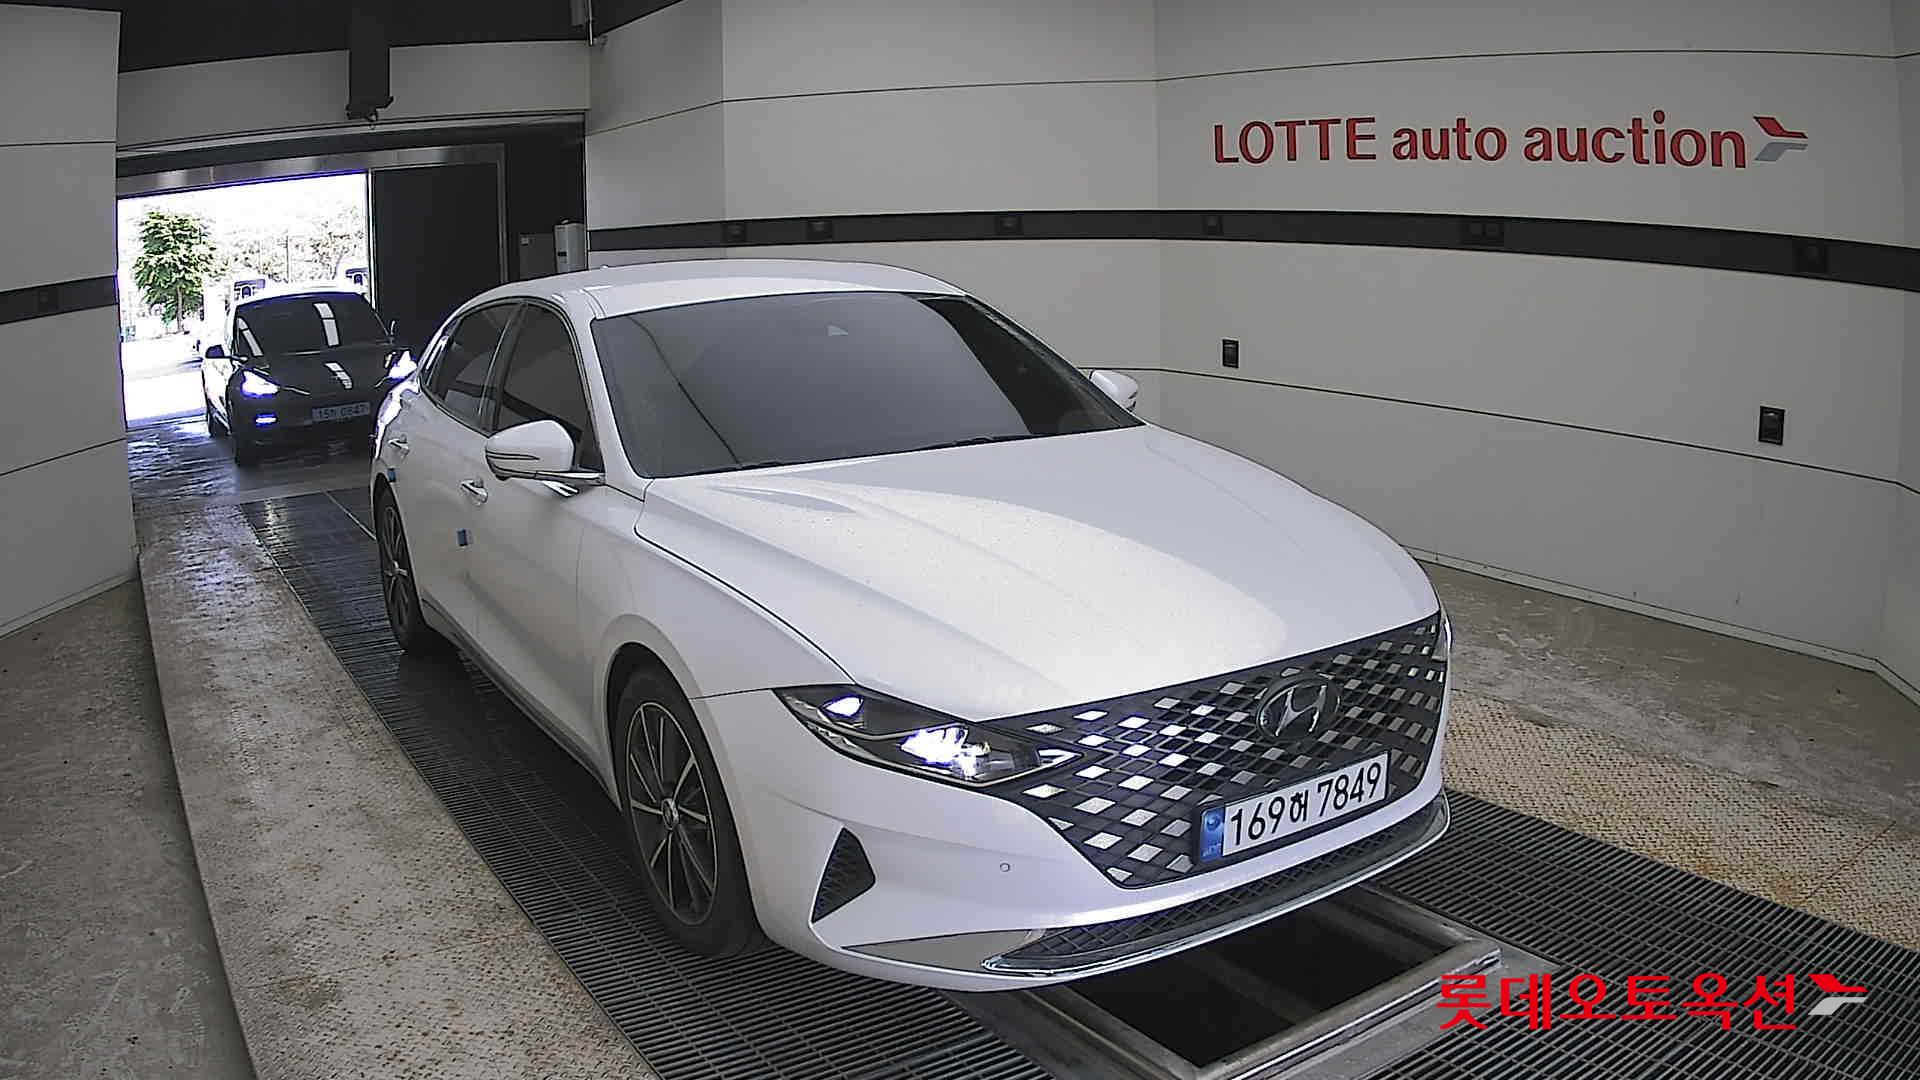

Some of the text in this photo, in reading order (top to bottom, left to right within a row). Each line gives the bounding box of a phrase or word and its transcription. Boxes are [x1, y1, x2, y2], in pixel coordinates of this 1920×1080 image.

[1214, 109, 1746, 169] LOTTE auto auction
[1230, 762, 1382, 846] 169허 7849
